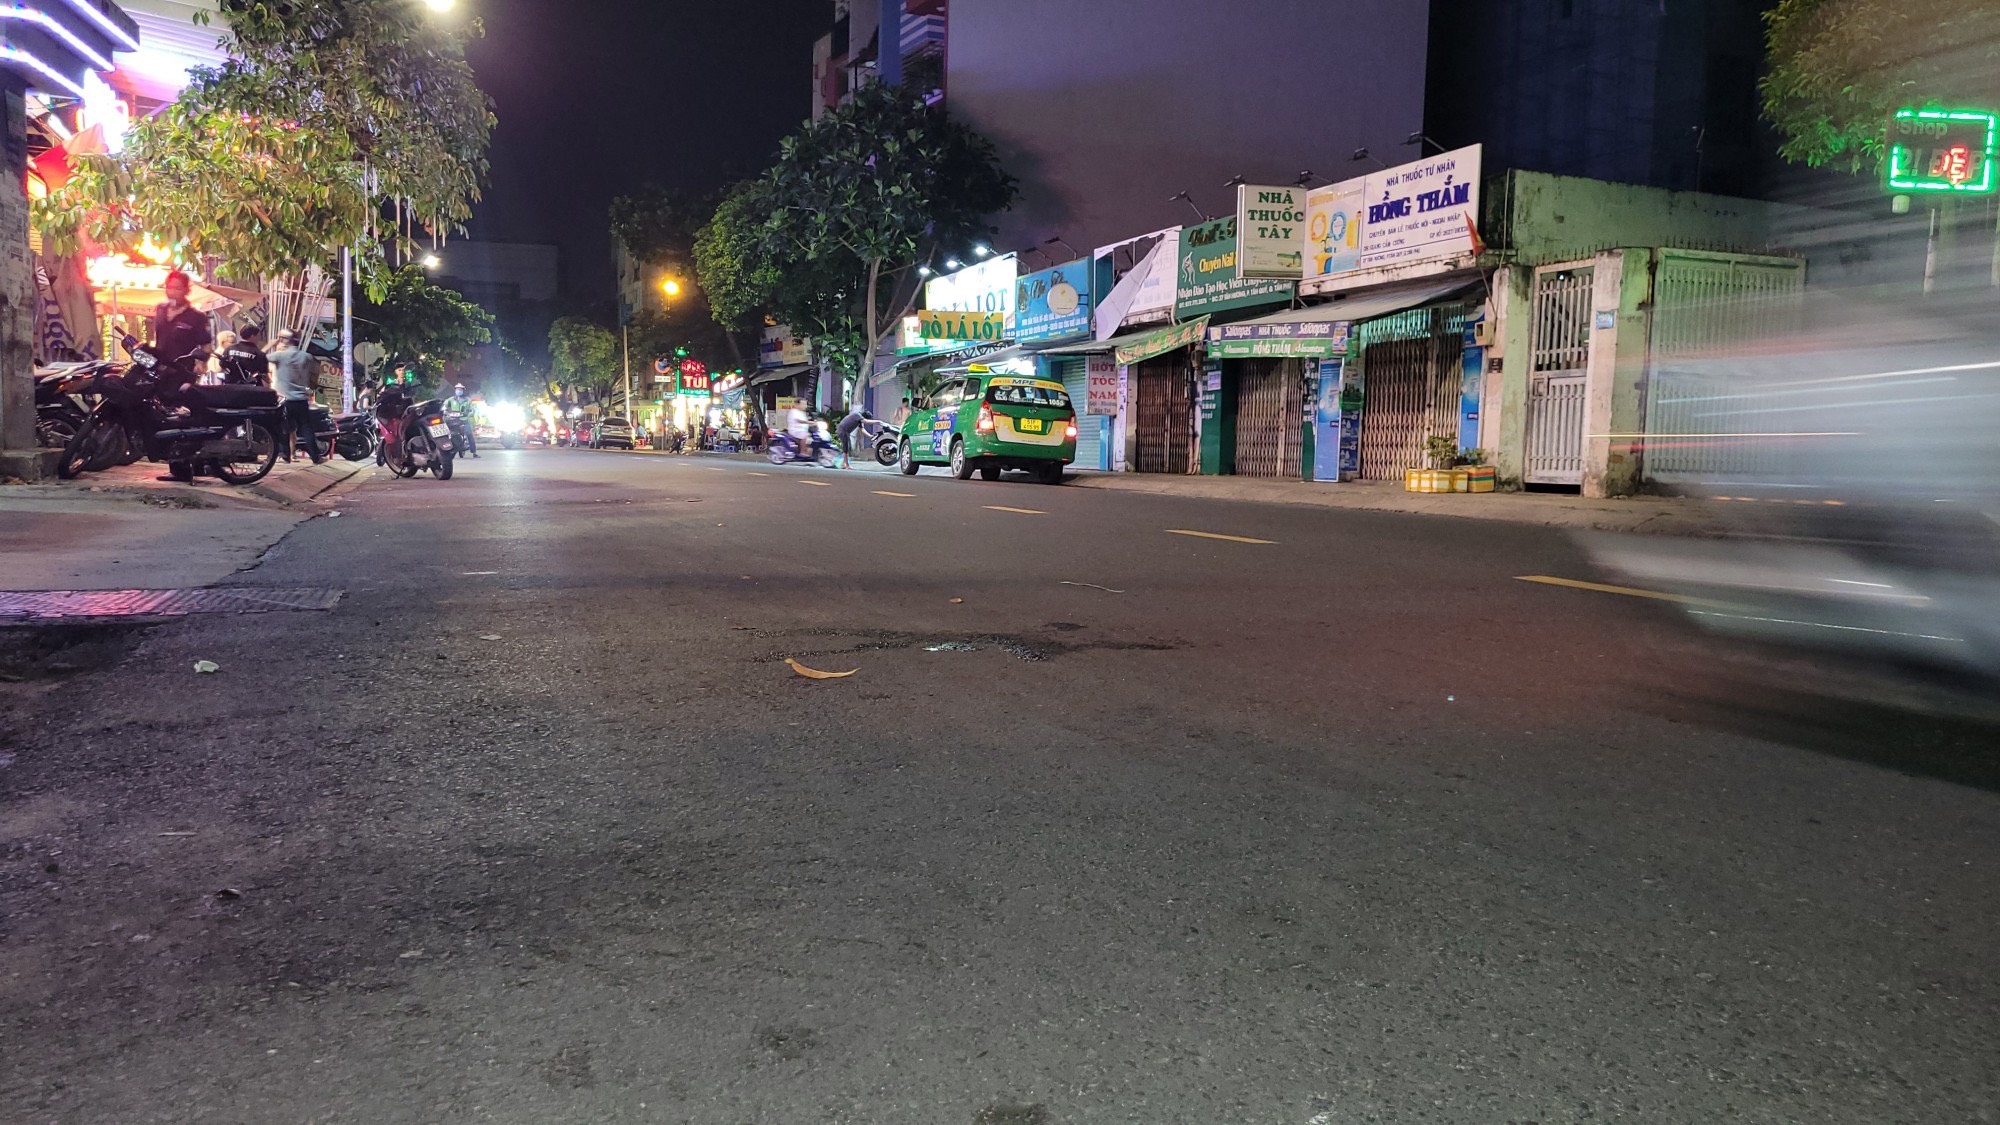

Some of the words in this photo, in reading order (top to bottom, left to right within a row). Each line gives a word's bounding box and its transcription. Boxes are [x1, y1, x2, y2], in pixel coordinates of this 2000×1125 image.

[1386, 173, 1399, 187] NHÀ
[1402, 164, 1423, 183] THUỐC
[1425, 162, 1435, 176] TƯ
[1437, 158, 1456, 174] NHÂN
[1258, 190, 1294, 204] NHÀ
[1368, 190, 1411, 224] HỒNG
[1416, 174, 1471, 213] THẮM
[1247, 206, 1304, 222] THUỐC
[1258, 224, 1293, 239] TÂY
[920, 314, 943, 339] BÒ
[946, 315, 967, 339] LÁ
[972, 313, 1003, 340] LỐT
[229, 350, 256, 359] SECURITY
[1091, 374, 1116, 386] TÓC
[1089, 390, 1117, 399] NAM
